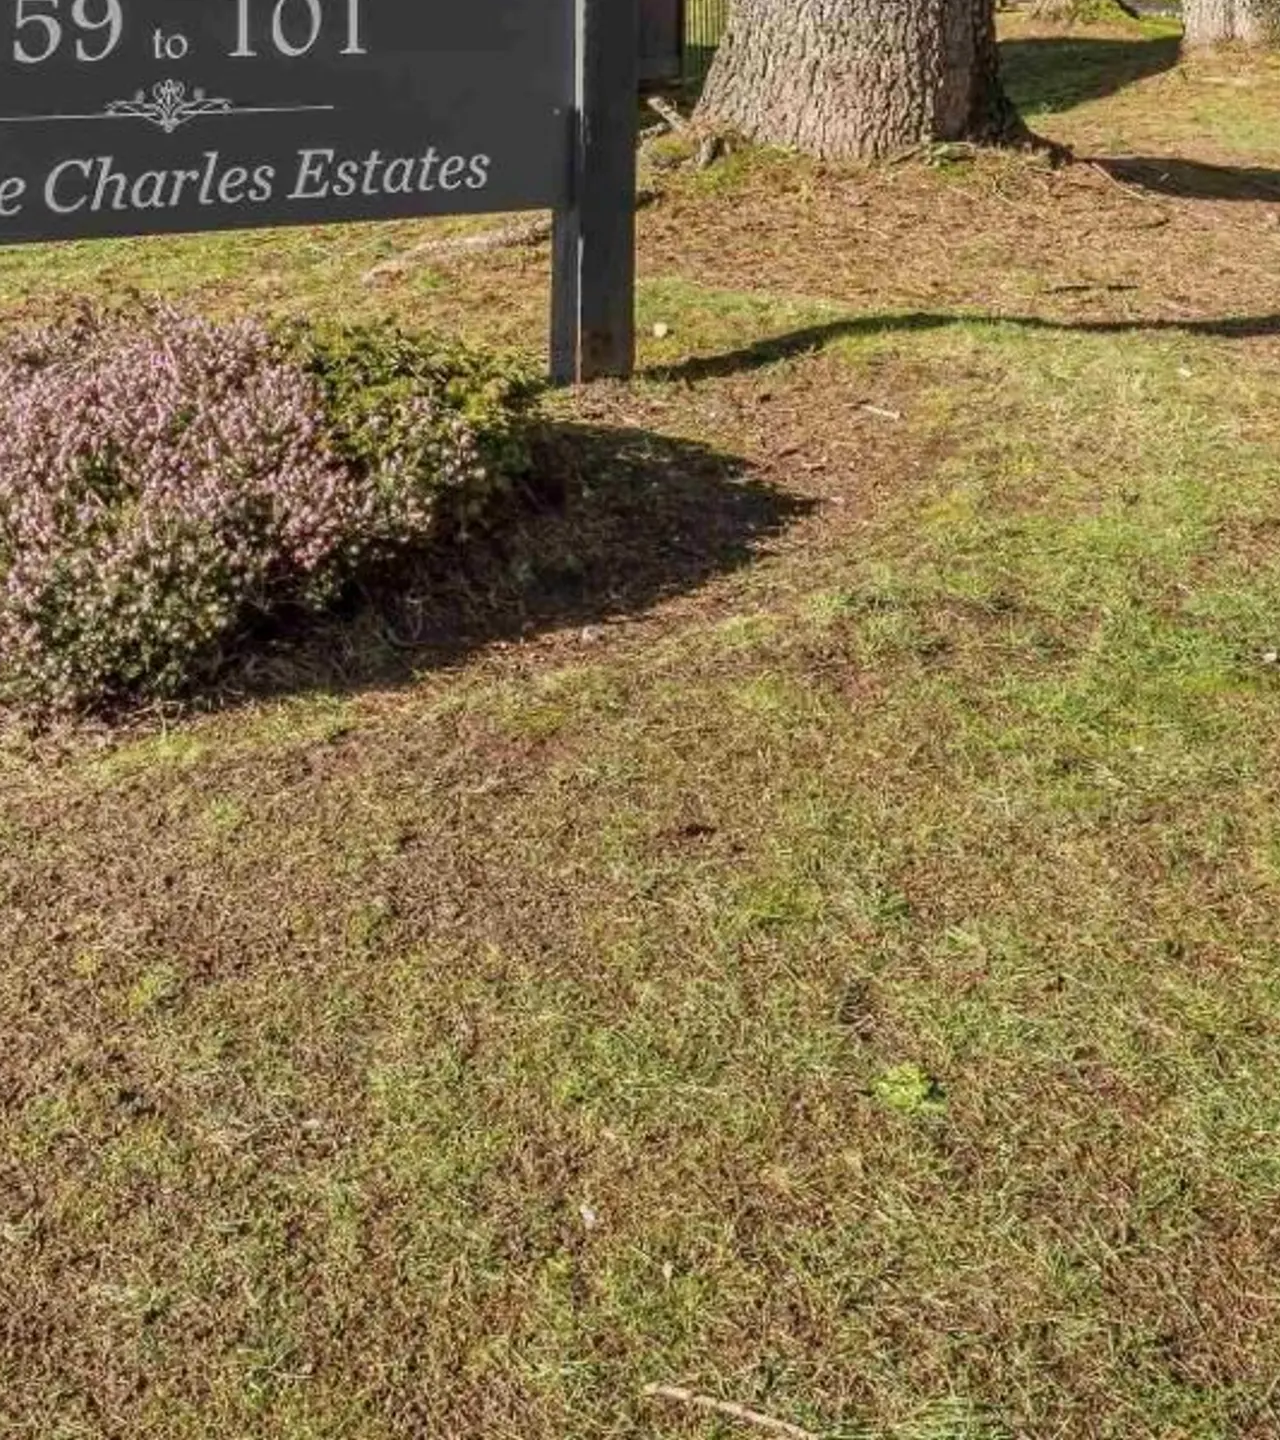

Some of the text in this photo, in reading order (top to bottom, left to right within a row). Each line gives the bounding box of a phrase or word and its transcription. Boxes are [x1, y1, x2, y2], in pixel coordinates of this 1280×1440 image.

[153, 29, 189, 60] to
[45, 152, 275, 213] Charles
[287, 148, 491, 200] Estates
